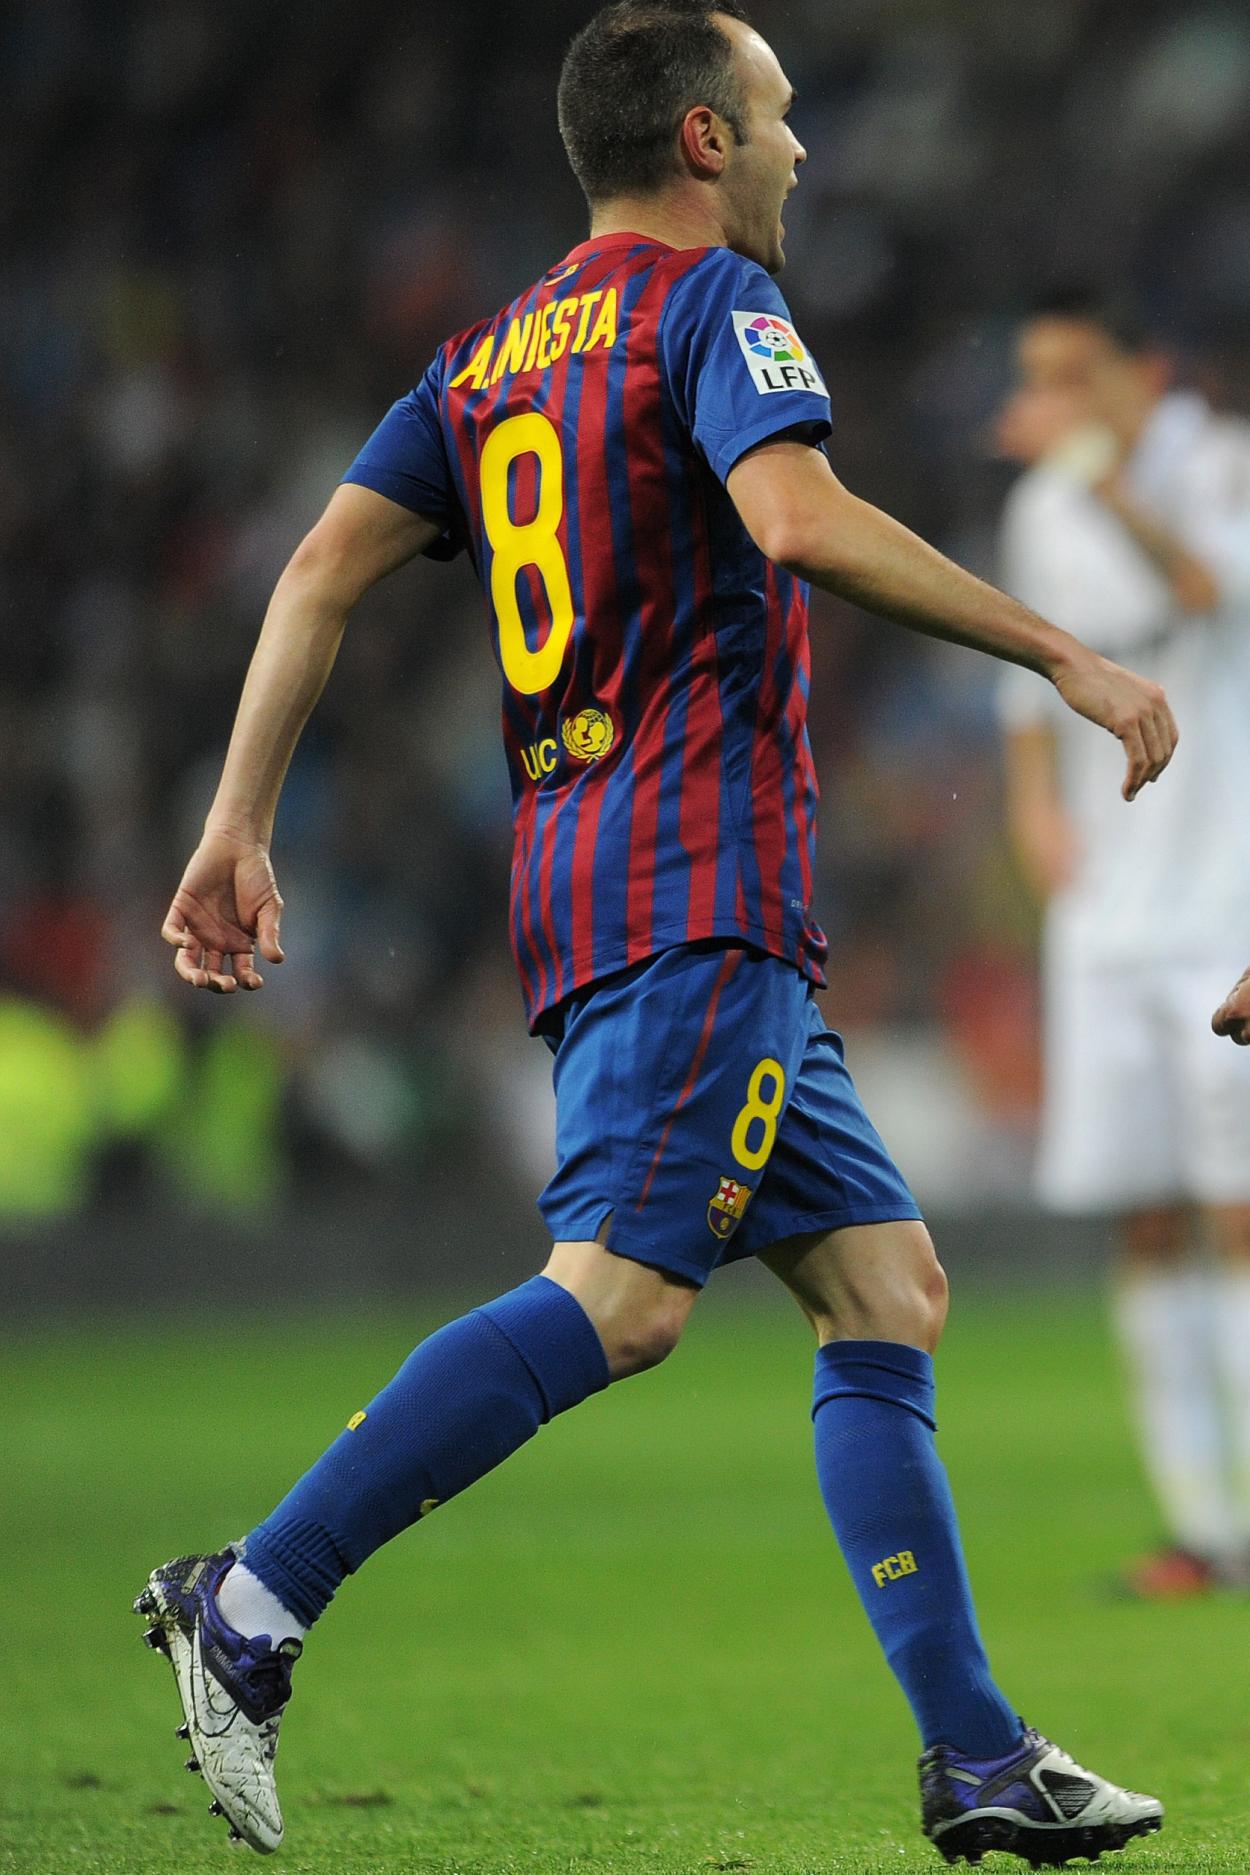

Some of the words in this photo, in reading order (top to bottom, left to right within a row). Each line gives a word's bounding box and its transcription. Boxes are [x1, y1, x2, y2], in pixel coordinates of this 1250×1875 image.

[760, 366, 816, 390] LFP
[480, 413, 575, 695] 8
[731, 1057, 785, 1171] 8
[871, 1550, 919, 1589] FCB
